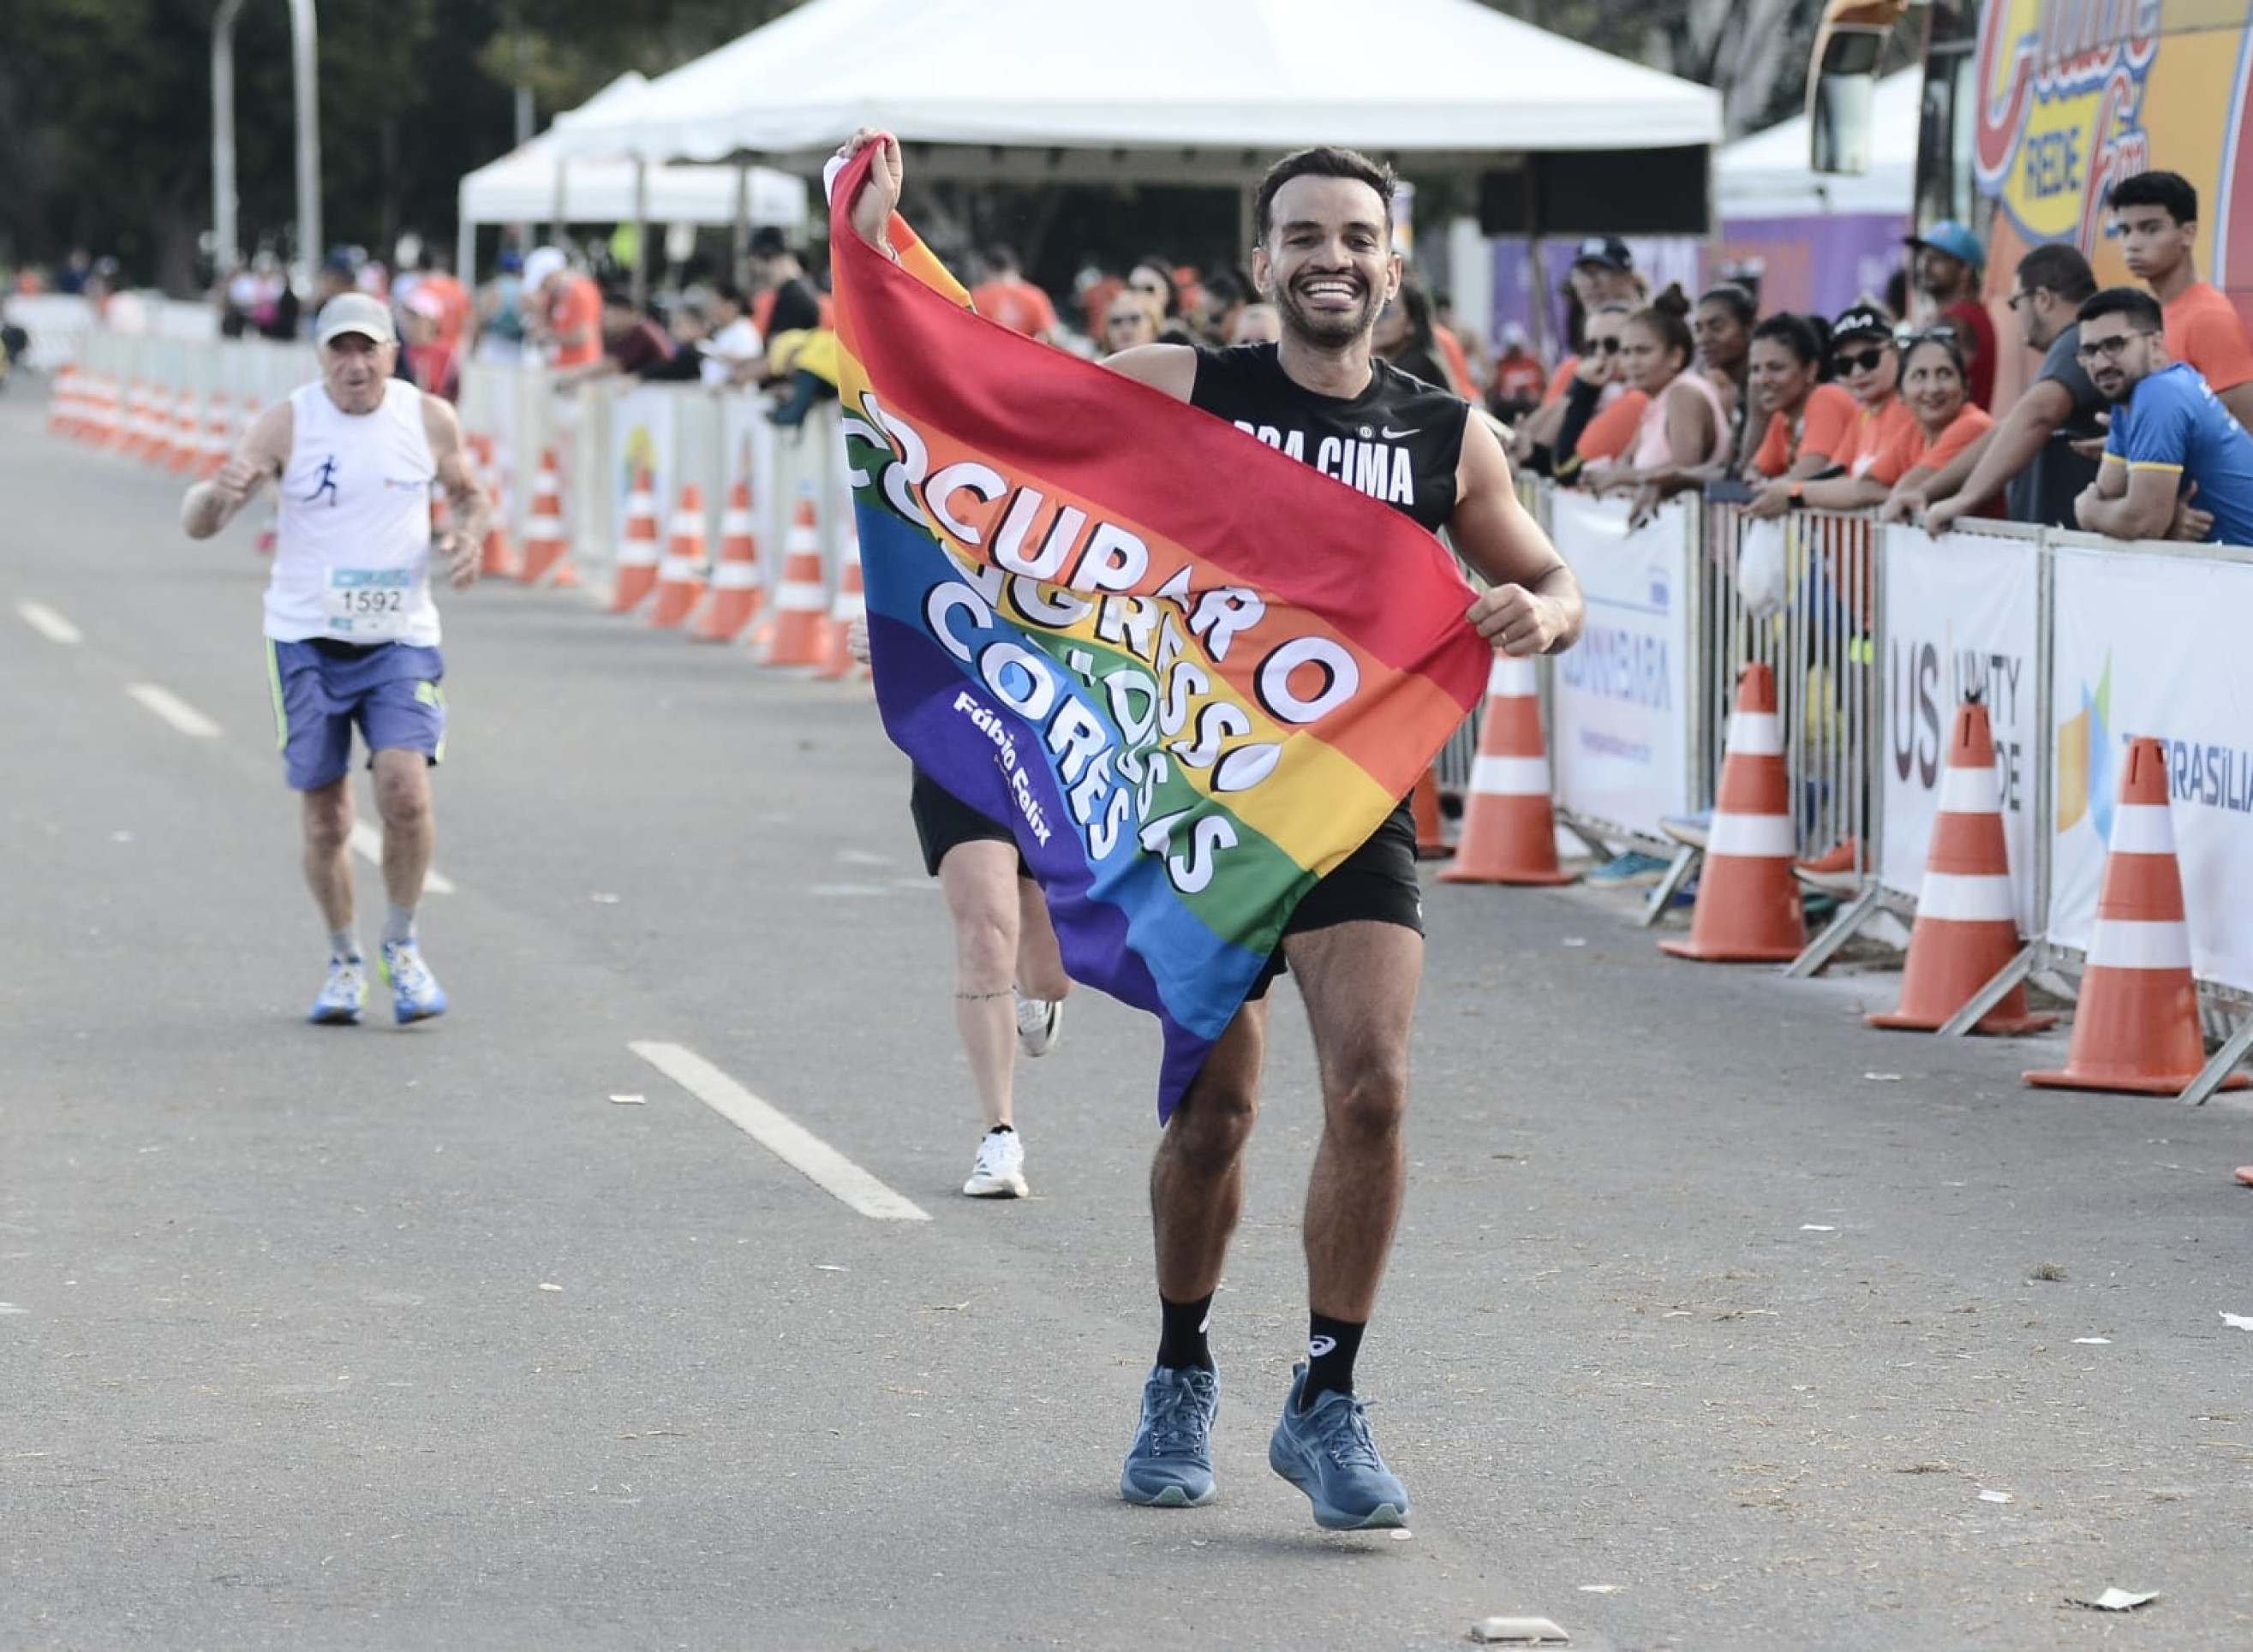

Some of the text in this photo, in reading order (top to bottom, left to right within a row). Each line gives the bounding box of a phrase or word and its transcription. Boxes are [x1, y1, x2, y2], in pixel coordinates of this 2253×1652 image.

[1317, 436, 1415, 505] CIMA
[343, 589, 401, 612] 1592
[921, 581, 1129, 860] CORES
[1254, 636, 1360, 725] O
[1891, 638, 1940, 790] US
[953, 691, 1016, 771] Fábio
[1012, 767, 1053, 848] Felix
